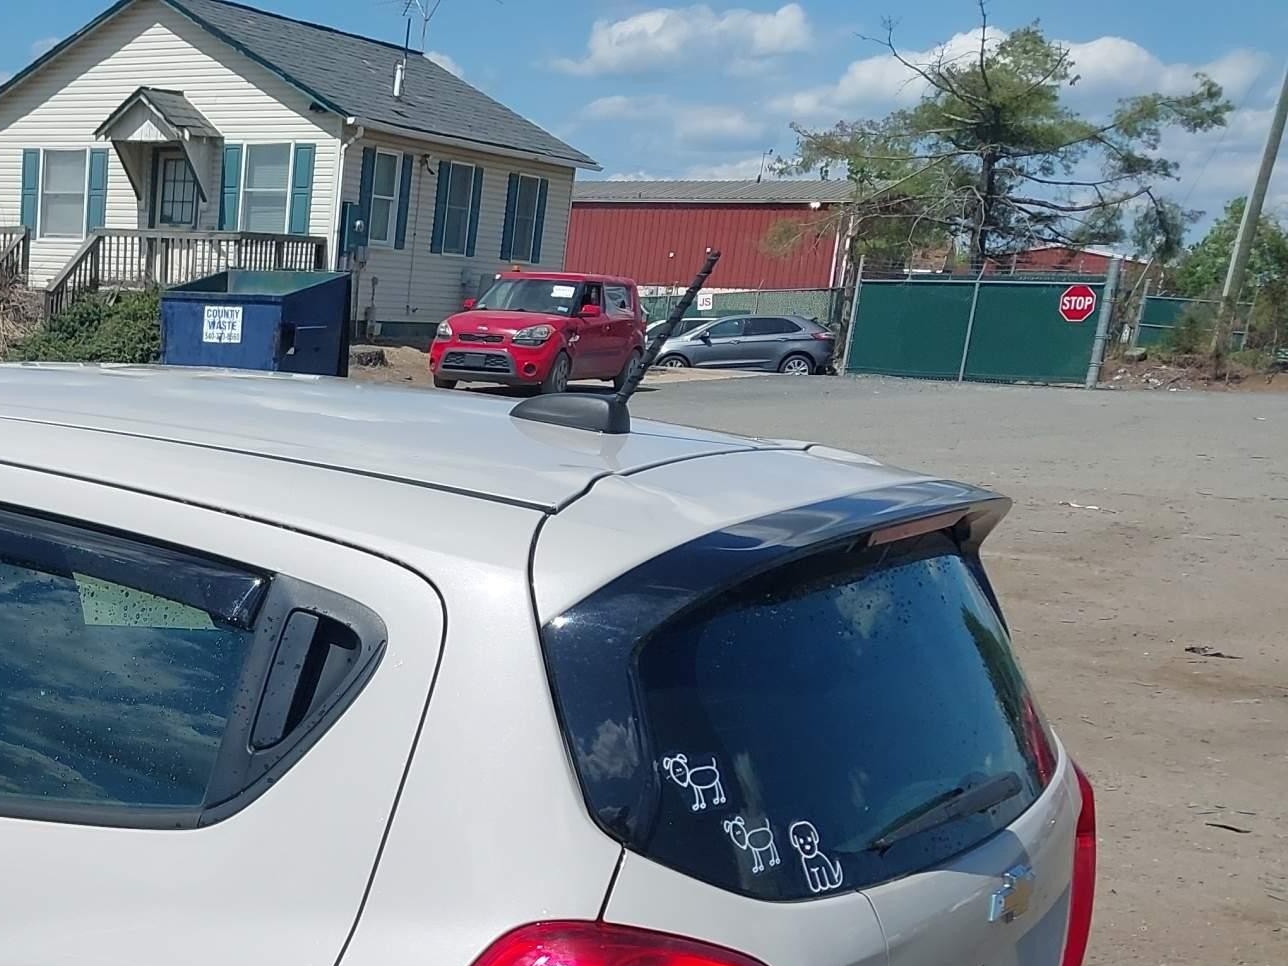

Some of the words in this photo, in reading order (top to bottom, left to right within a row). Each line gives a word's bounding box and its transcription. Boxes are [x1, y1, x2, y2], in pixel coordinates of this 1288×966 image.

[1062, 296, 1093, 310] STOP
[206, 308, 241, 319] COUNTY
[207, 320, 237, 331] WASTE
